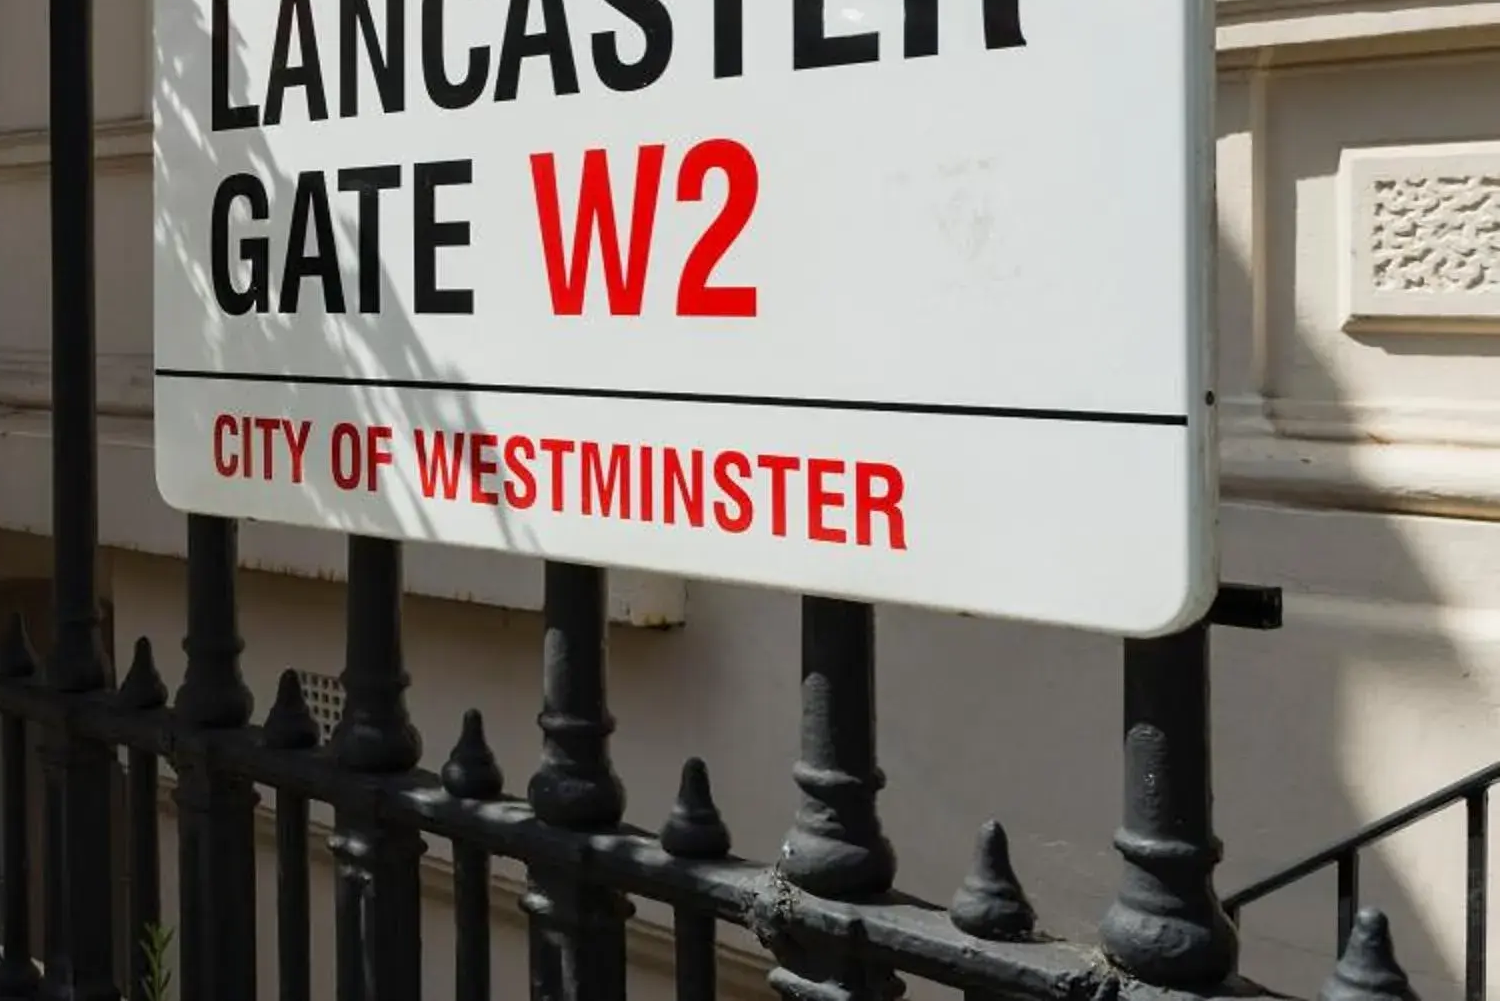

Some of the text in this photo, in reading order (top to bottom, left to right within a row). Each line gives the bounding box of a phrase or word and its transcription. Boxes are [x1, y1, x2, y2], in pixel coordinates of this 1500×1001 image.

[211, 136, 760, 318] GATE W2
[212, 413, 907, 554] CITY OF WESTMINSTER
